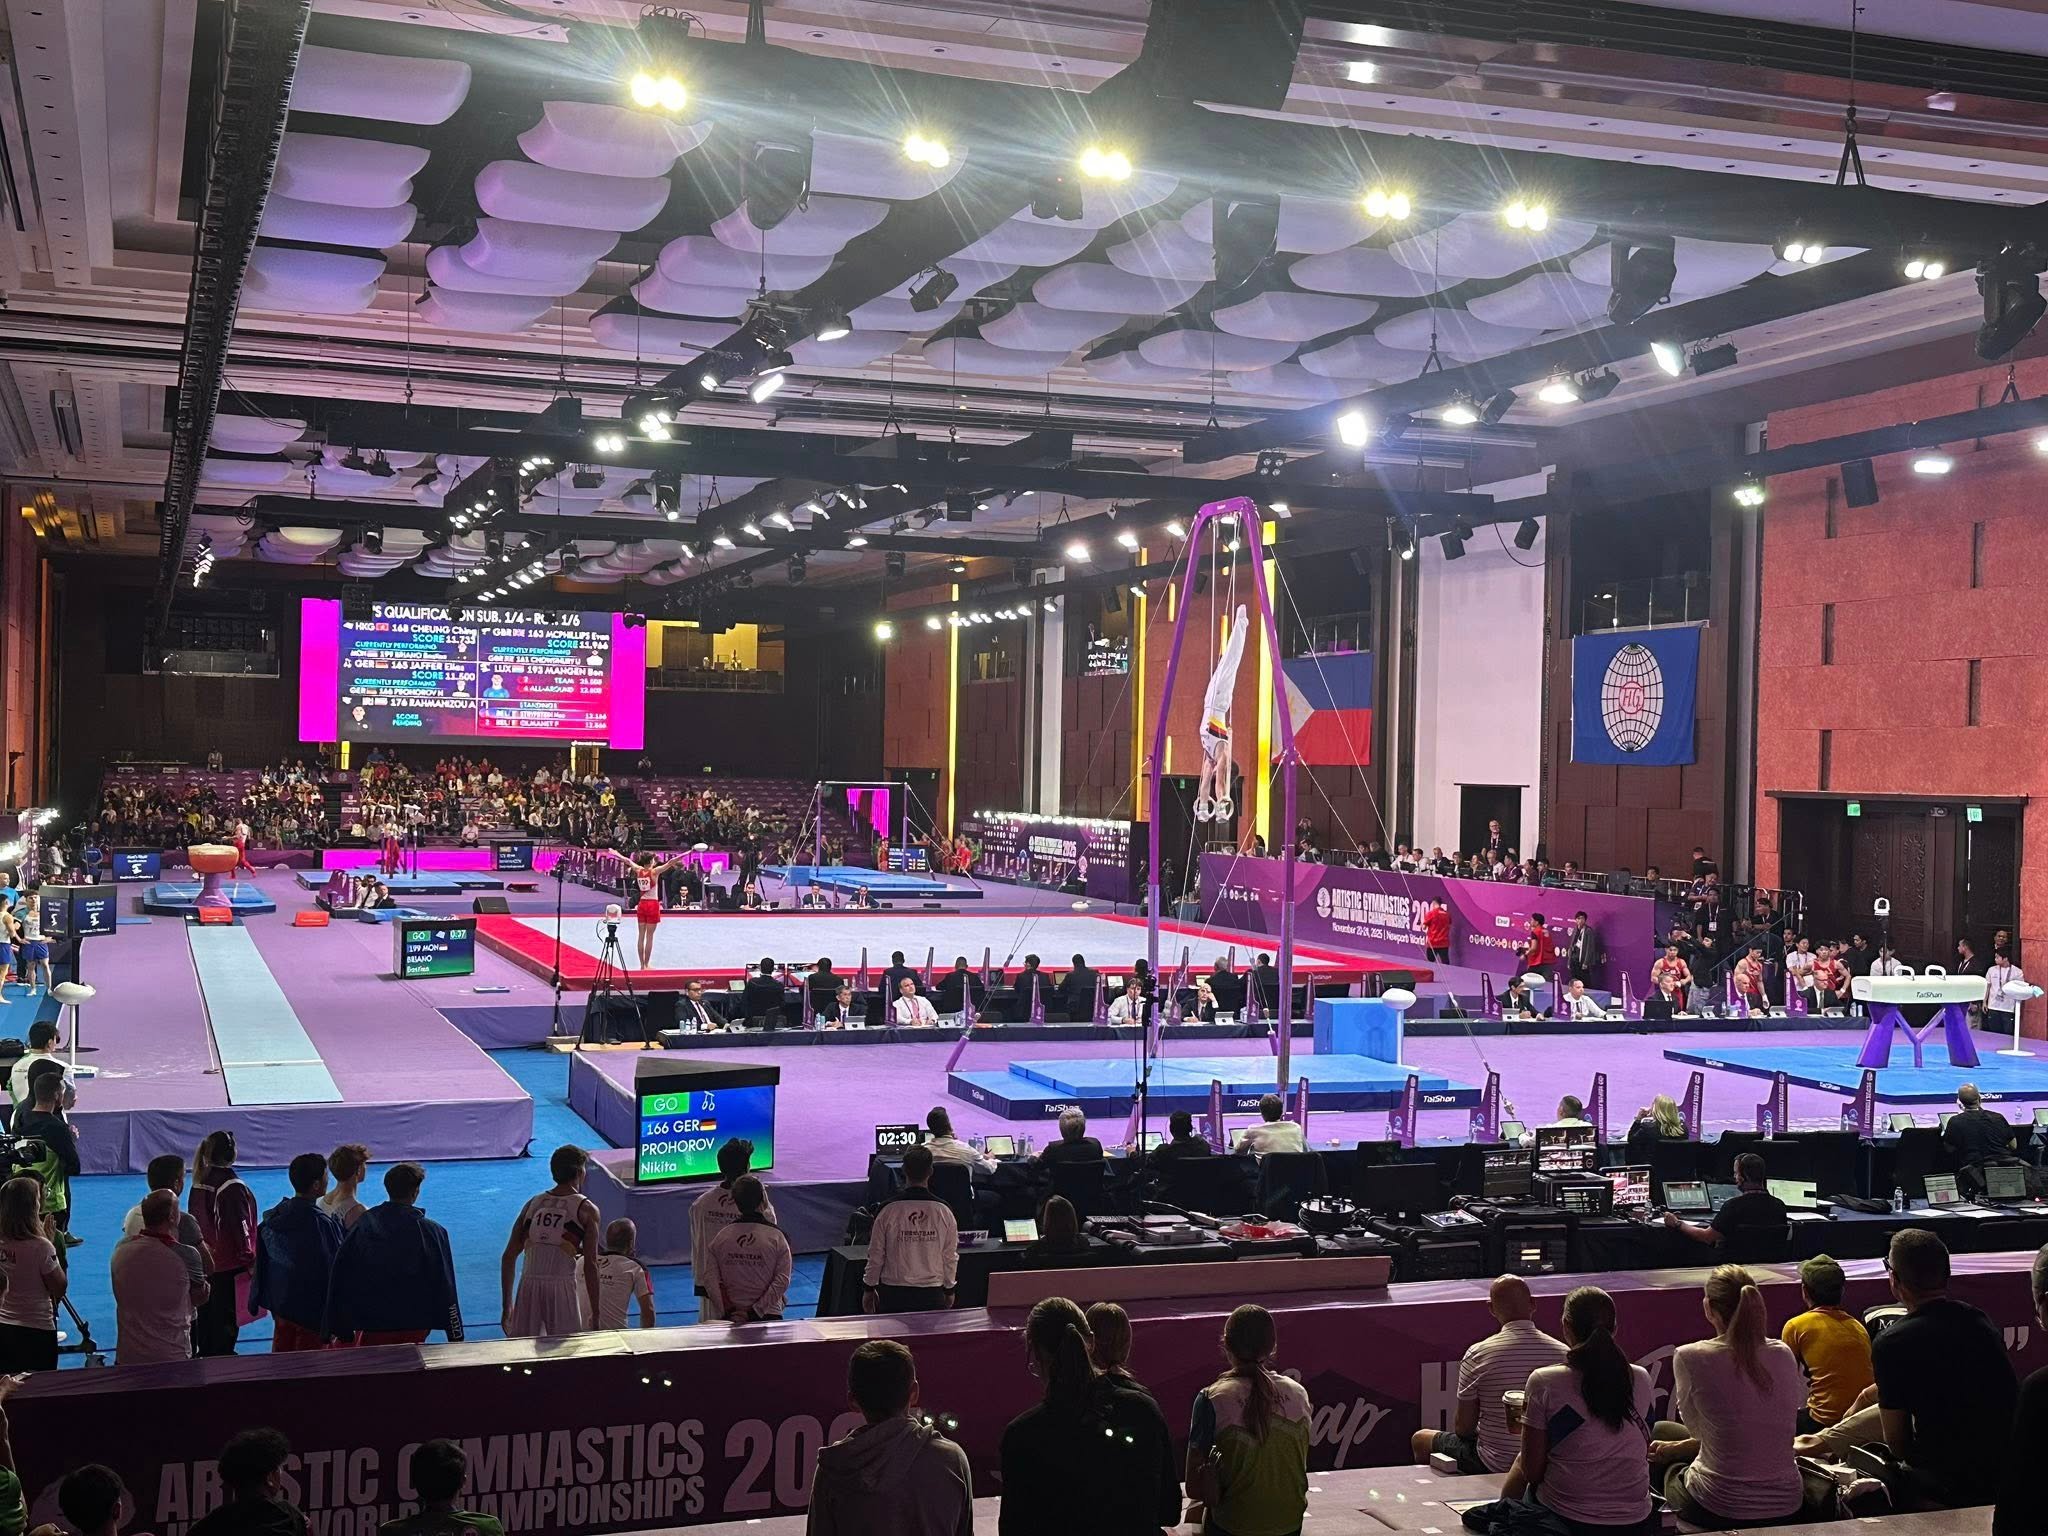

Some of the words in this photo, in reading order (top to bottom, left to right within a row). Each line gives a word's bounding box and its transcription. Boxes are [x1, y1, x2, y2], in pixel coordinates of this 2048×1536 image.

[477, 610, 501, 623] SUB.
[504, 611, 525, 624] 1/4
[561, 614, 580, 627] 1/6
[355, 622, 375, 631] HKG
[392, 624, 409, 632] 168
[411, 624, 450, 635] CHEUNG
[412, 634, 445, 643] SCORE
[548, 639, 578, 649] SCORE
[355, 660, 374, 668] GER
[410, 660, 442, 671] JAFFER
[494, 664, 512, 673] LUX
[527, 665, 544, 674] 193
[412, 671, 443, 680] SCORE
[390, 698, 408, 707] 176
[1332, 887, 1362, 910] ARTISTIC
[1362, 892, 1410, 917] GYMNASTICS
[412, 932, 425, 940] GO
[422, 943, 439, 952] MON
[406, 955, 432, 963] BRIANO
[653, 1096, 678, 1112] GO
[1237, 1099, 1260, 1107] TaiSh
[1423, 1095, 1455, 1103] TaiShan
[646, 1121, 669, 1136] 166
[673, 1119, 700, 1133] GER
[878, 1131, 917, 1146] 02:30
[641, 1137, 715, 1157] PROHOROV
[641, 1160, 677, 1175] Nikita
[535, 1212, 563, 1229] 167
[154, 1446, 381, 1524] ARSTIC
